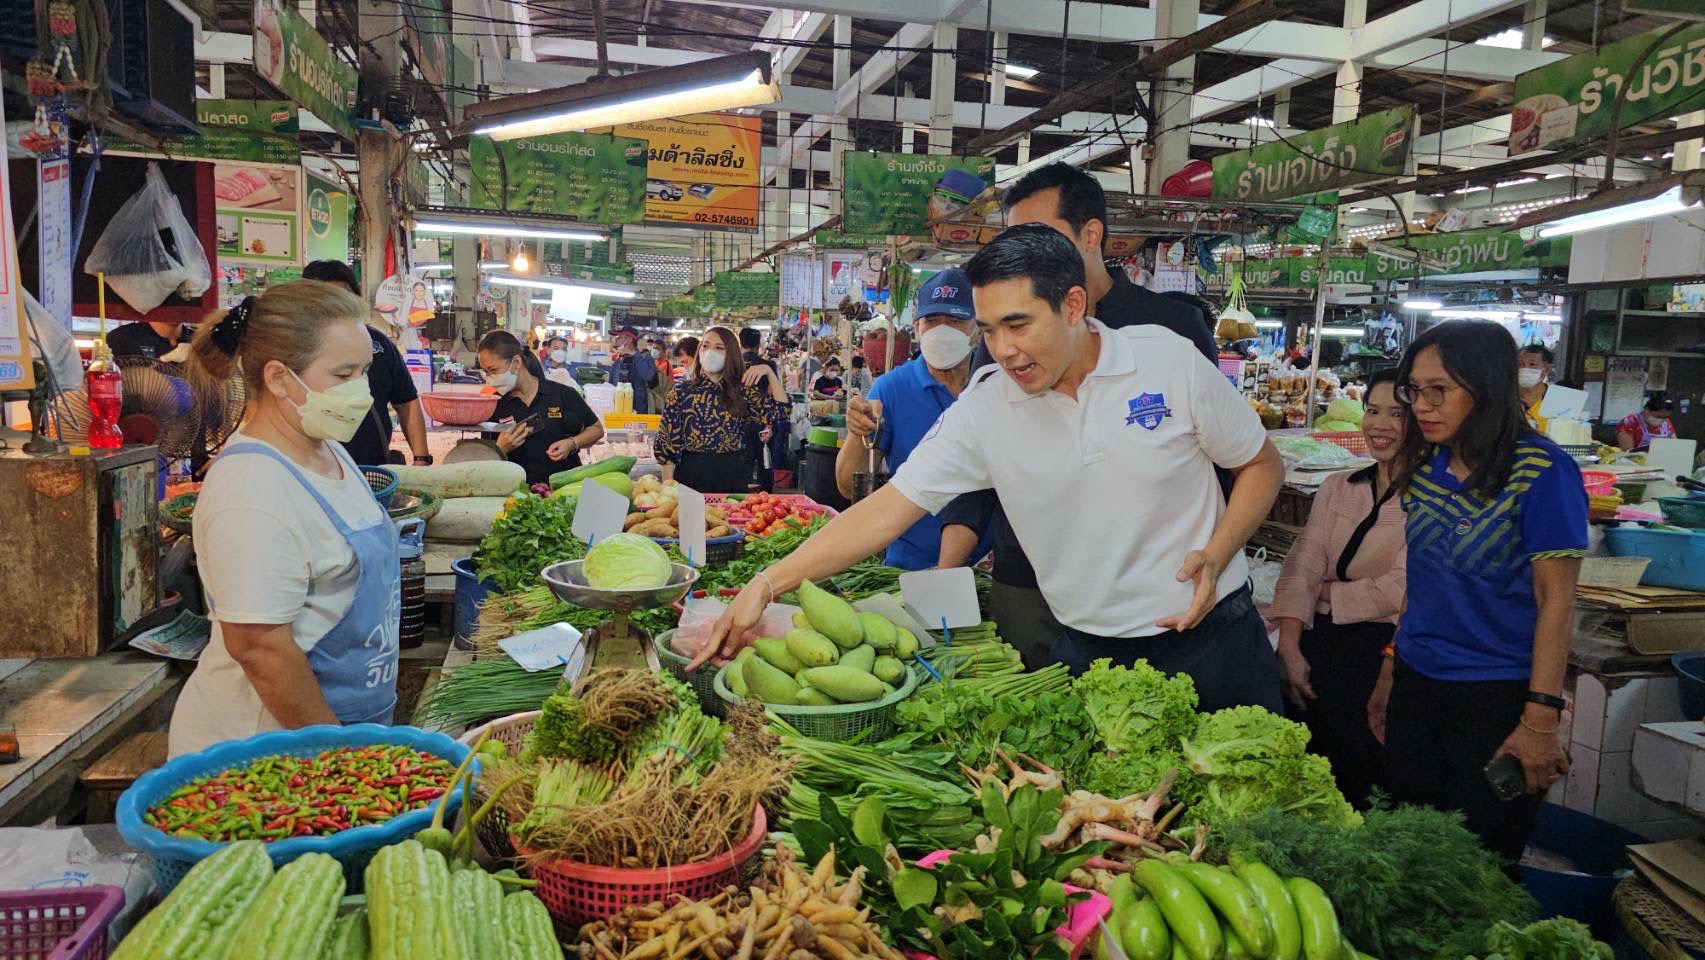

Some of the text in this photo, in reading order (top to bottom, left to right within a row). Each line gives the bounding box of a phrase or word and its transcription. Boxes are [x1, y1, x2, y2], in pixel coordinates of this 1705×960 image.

[647, 143, 745, 169] มด้าลิสซิ่ง
[694, 212, 755, 226] 02-5746901
